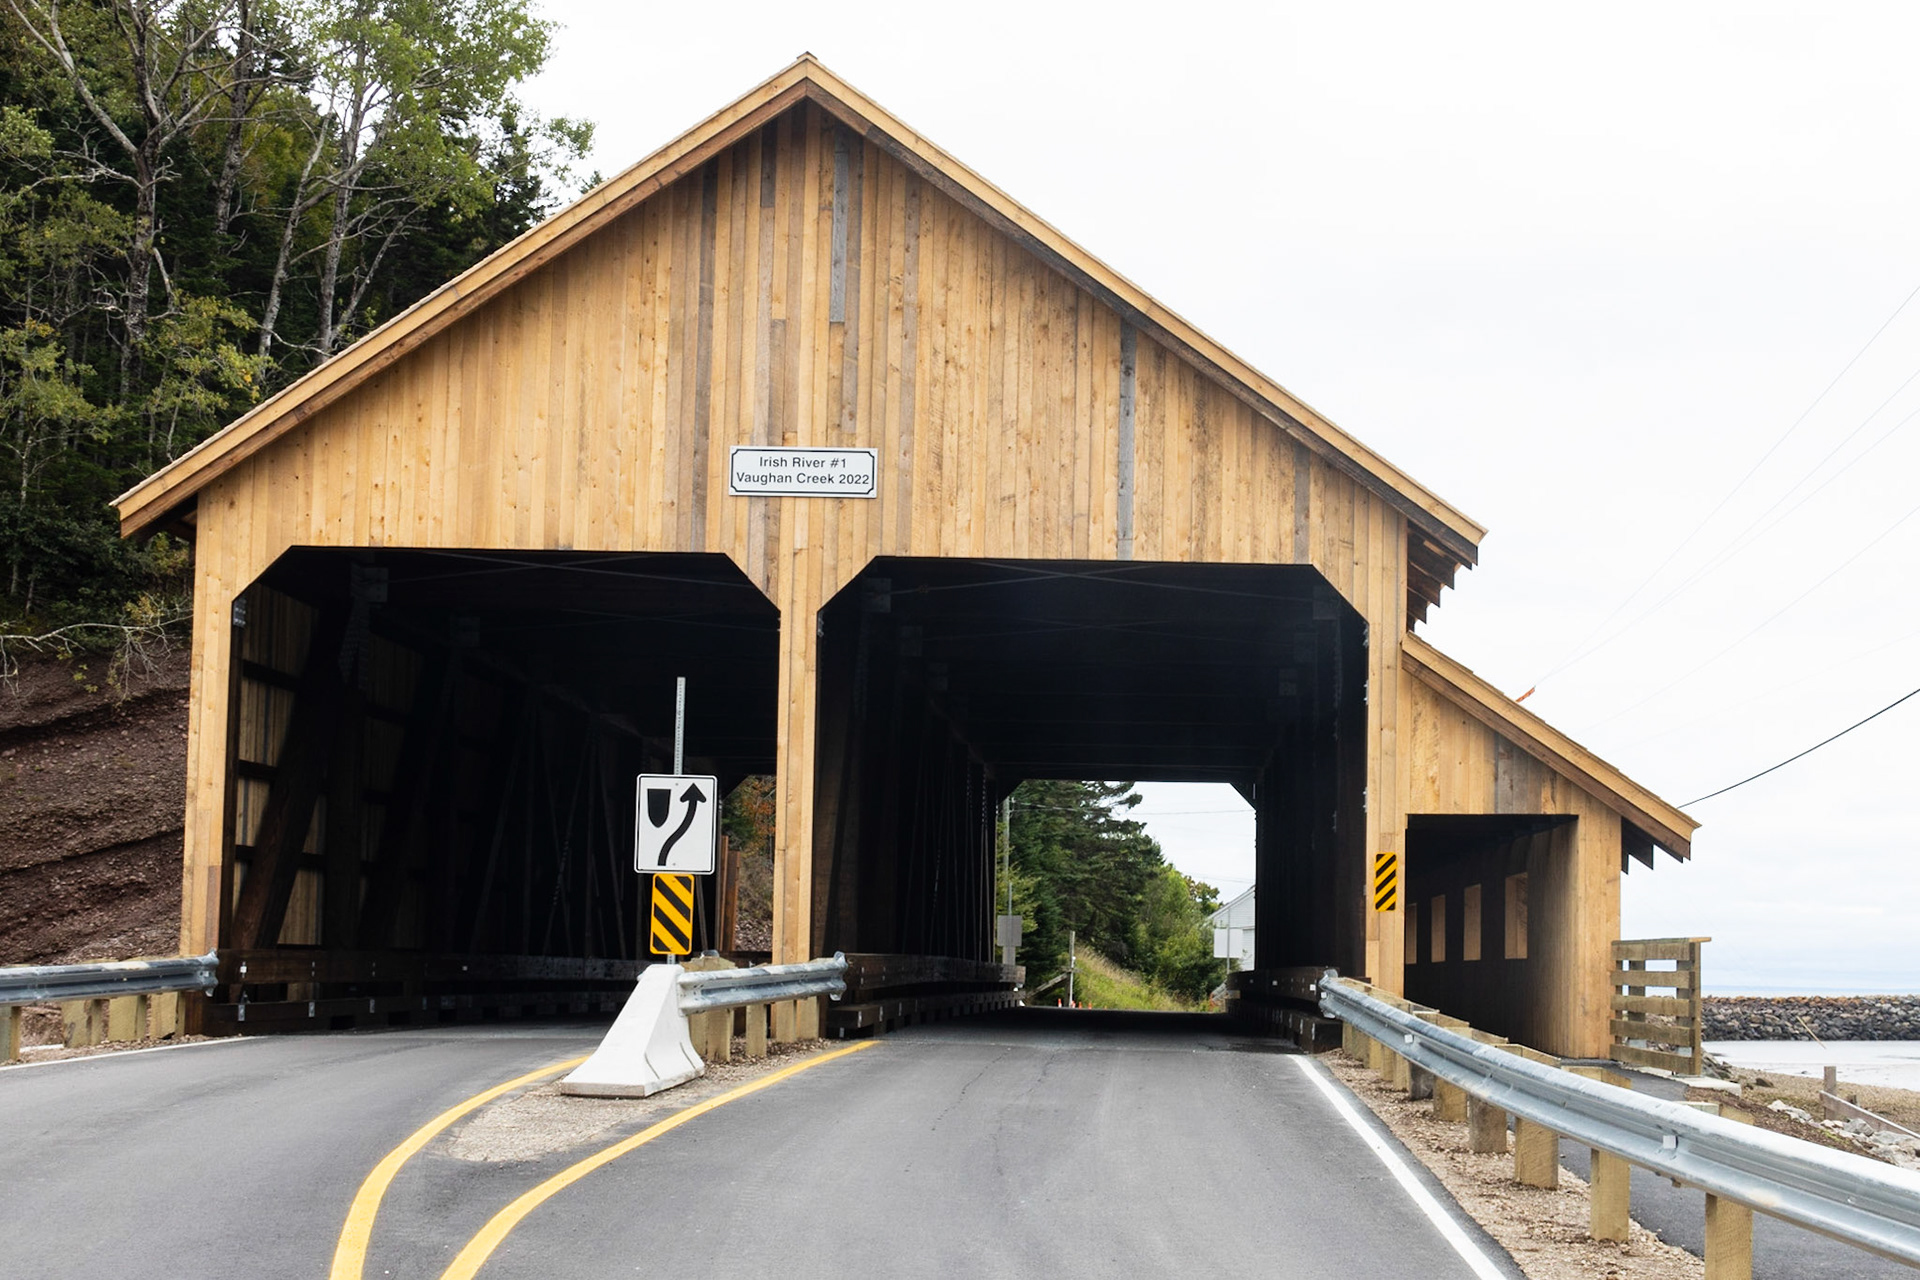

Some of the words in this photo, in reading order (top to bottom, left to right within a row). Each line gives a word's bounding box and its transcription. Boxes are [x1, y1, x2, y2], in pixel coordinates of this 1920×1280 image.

[759, 456, 788, 468] Irish
[792, 457, 826, 468] River
[830, 457, 847, 468] #1
[736, 471, 792, 486] Vaughan
[796, 473, 835, 484] Creek
[838, 474, 870, 485] 2022
